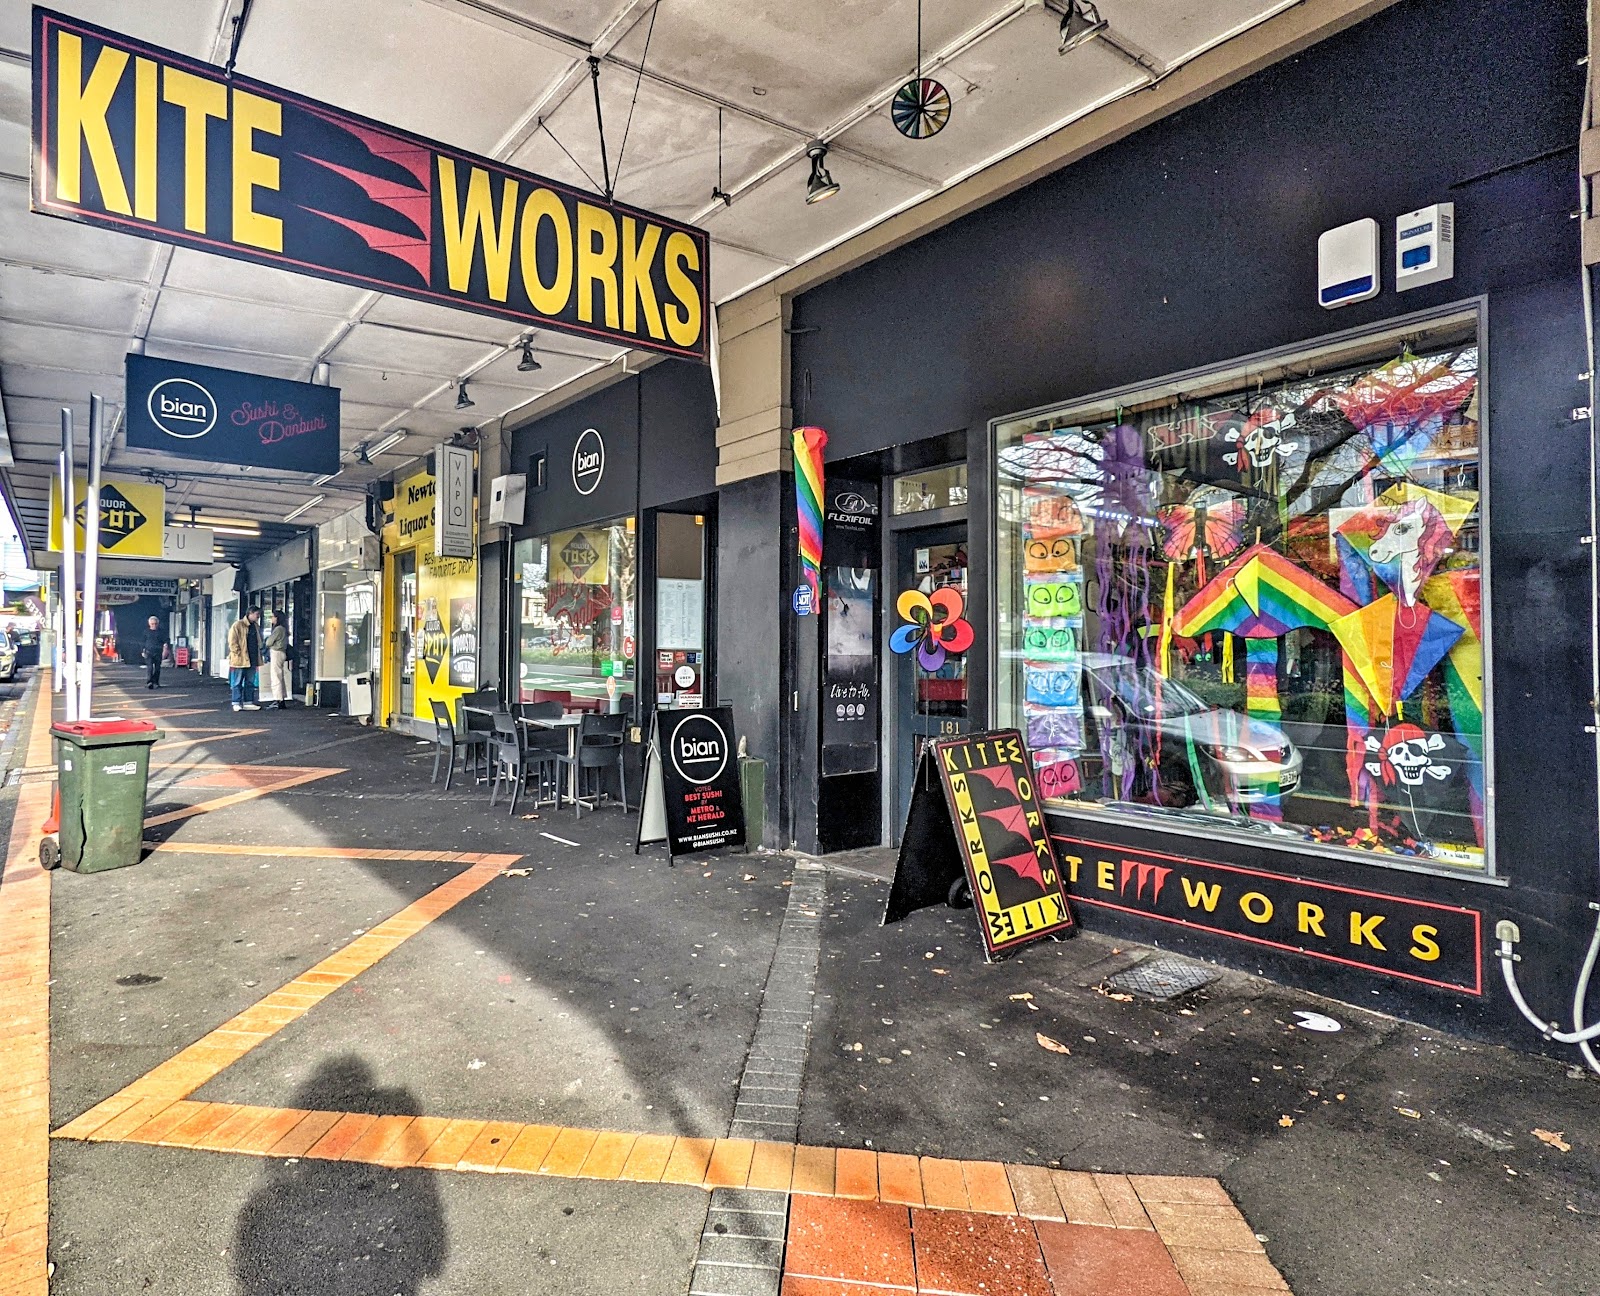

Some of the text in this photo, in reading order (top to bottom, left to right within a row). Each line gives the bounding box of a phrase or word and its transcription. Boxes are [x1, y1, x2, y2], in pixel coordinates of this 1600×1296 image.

[57, 30, 702, 347] KITE WORKS
[160, 394, 207, 418] bian
[231, 401, 299, 426] Sushi &
[578, 450, 600, 471] bian
[399, 514, 429, 538] Liquor
[827, 512, 873, 526] FLEXIFOIL
[458, 558, 473, 574] DROP
[139, 578, 175, 588] SUPERETTE
[830, 684, 847, 698] Live
[848, 685, 857, 698] to
[940, 721, 960, 734] 181
[681, 737, 719, 757] bian
[943, 741, 1007, 771] KITE
[684, 790, 723, 802] BEST SUSHI
[694, 785, 712, 793] VOTED
[686, 811, 725, 823] NZ HERALD
[690, 804, 715, 815] METRO
[1007, 738, 1056, 885] WORKS
[678, 828, 738, 844] WWW.BIANSUSHI.CO.NZ
[692, 837, 726, 848] @BIANSUSHI
[953, 779, 1002, 938] WORKS
[1000, 895, 1066, 938] KITE
[1181, 877, 1441, 962] WORKS
